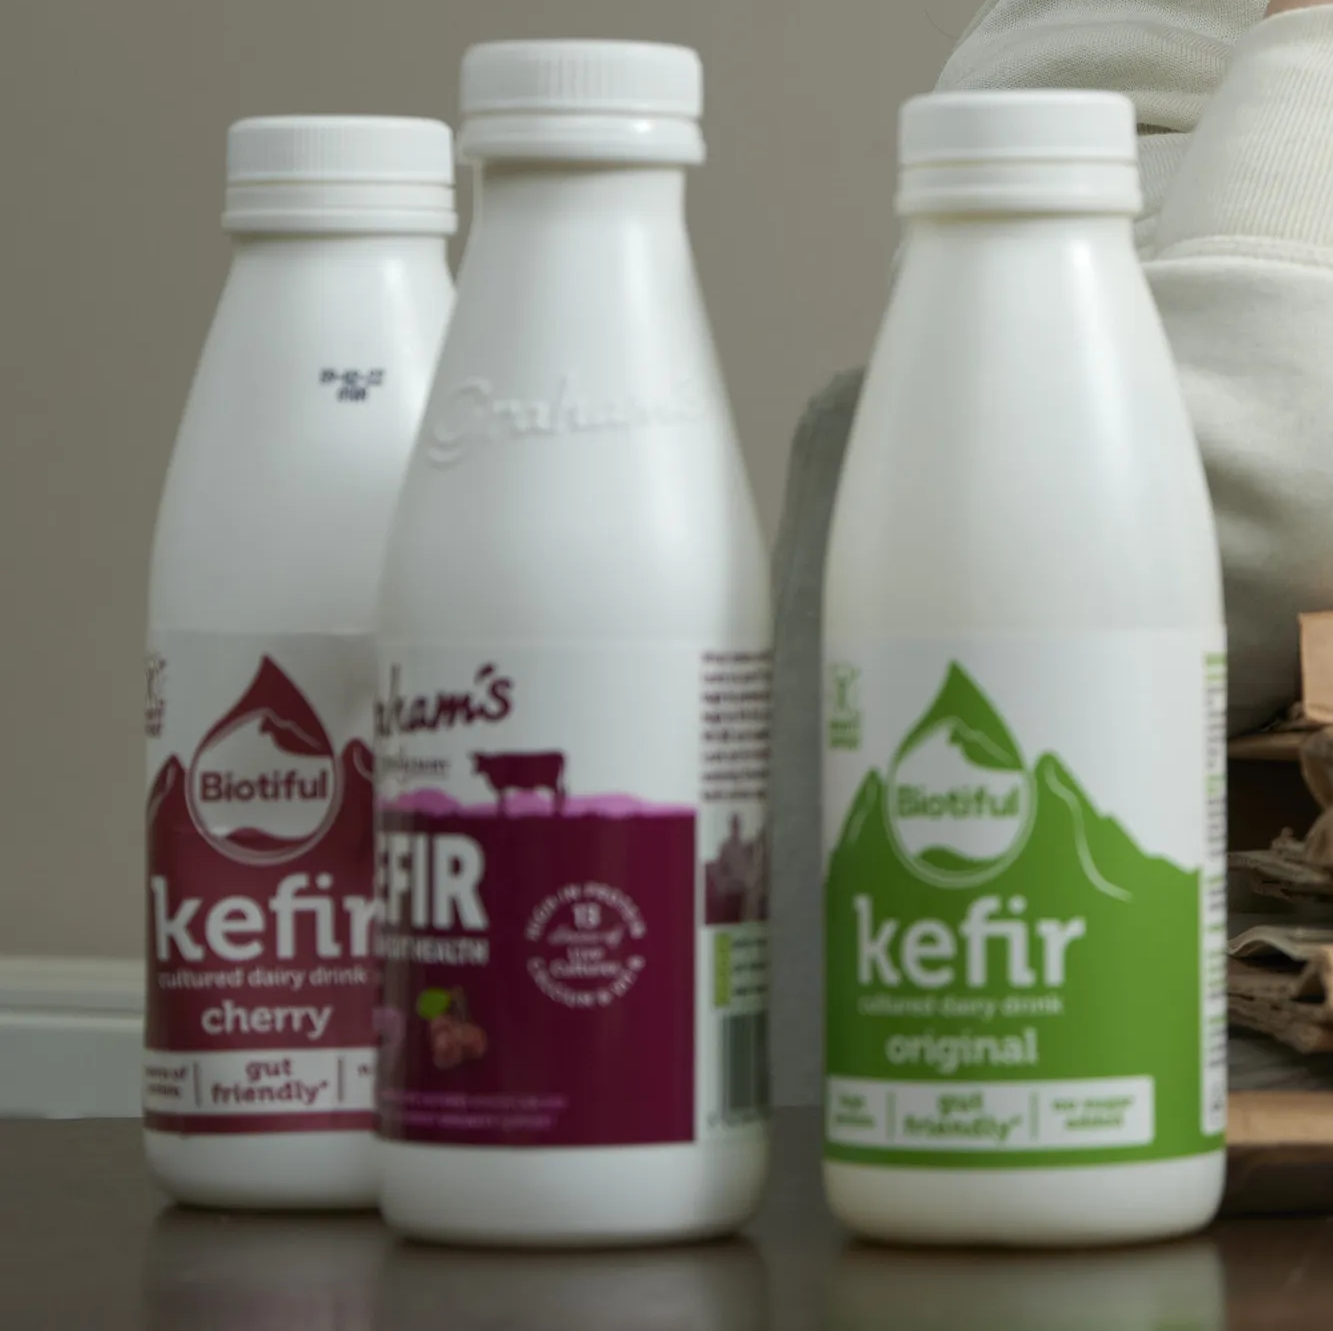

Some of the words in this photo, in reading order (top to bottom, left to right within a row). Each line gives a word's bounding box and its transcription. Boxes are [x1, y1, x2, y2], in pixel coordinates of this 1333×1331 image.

[200, 770, 331, 803] Biotiful
[896, 782, 1020, 820] Biotiful
[151, 872, 374, 962] kefir
[854, 894, 1087, 989] kefir
[248, 969, 305, 991] dairy
[309, 966, 368, 988] drink
[201, 998, 335, 1041] cherry
[245, 1058, 293, 1083] gut
[884, 1027, 1039, 1075] original
